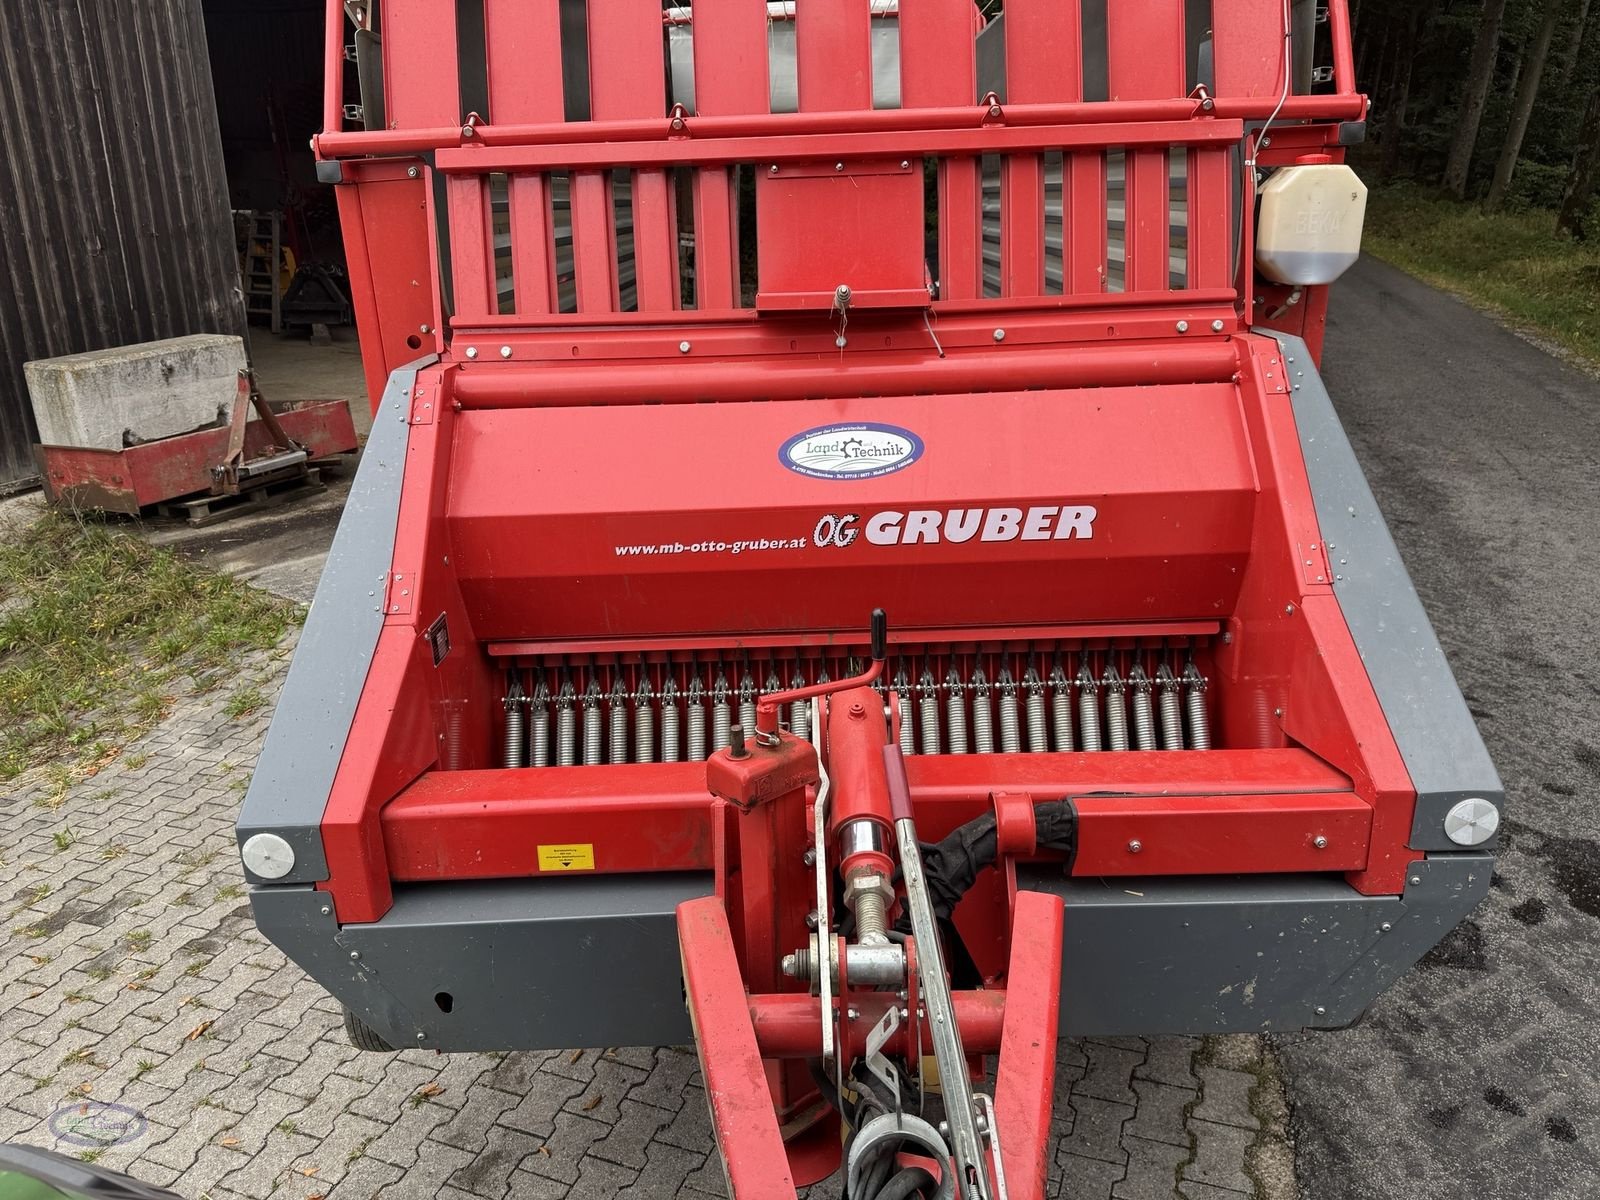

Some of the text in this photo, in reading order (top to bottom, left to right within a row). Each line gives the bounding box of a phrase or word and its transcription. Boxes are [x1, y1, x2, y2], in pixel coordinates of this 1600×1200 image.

[1296, 211, 1340, 234] BEKA
[806, 441, 839, 454] Land
[852, 444, 904, 458] Technik
[865, 505, 1097, 546] GRUBER
[615, 536, 807, 556] www.mb-otto-gruber.at
